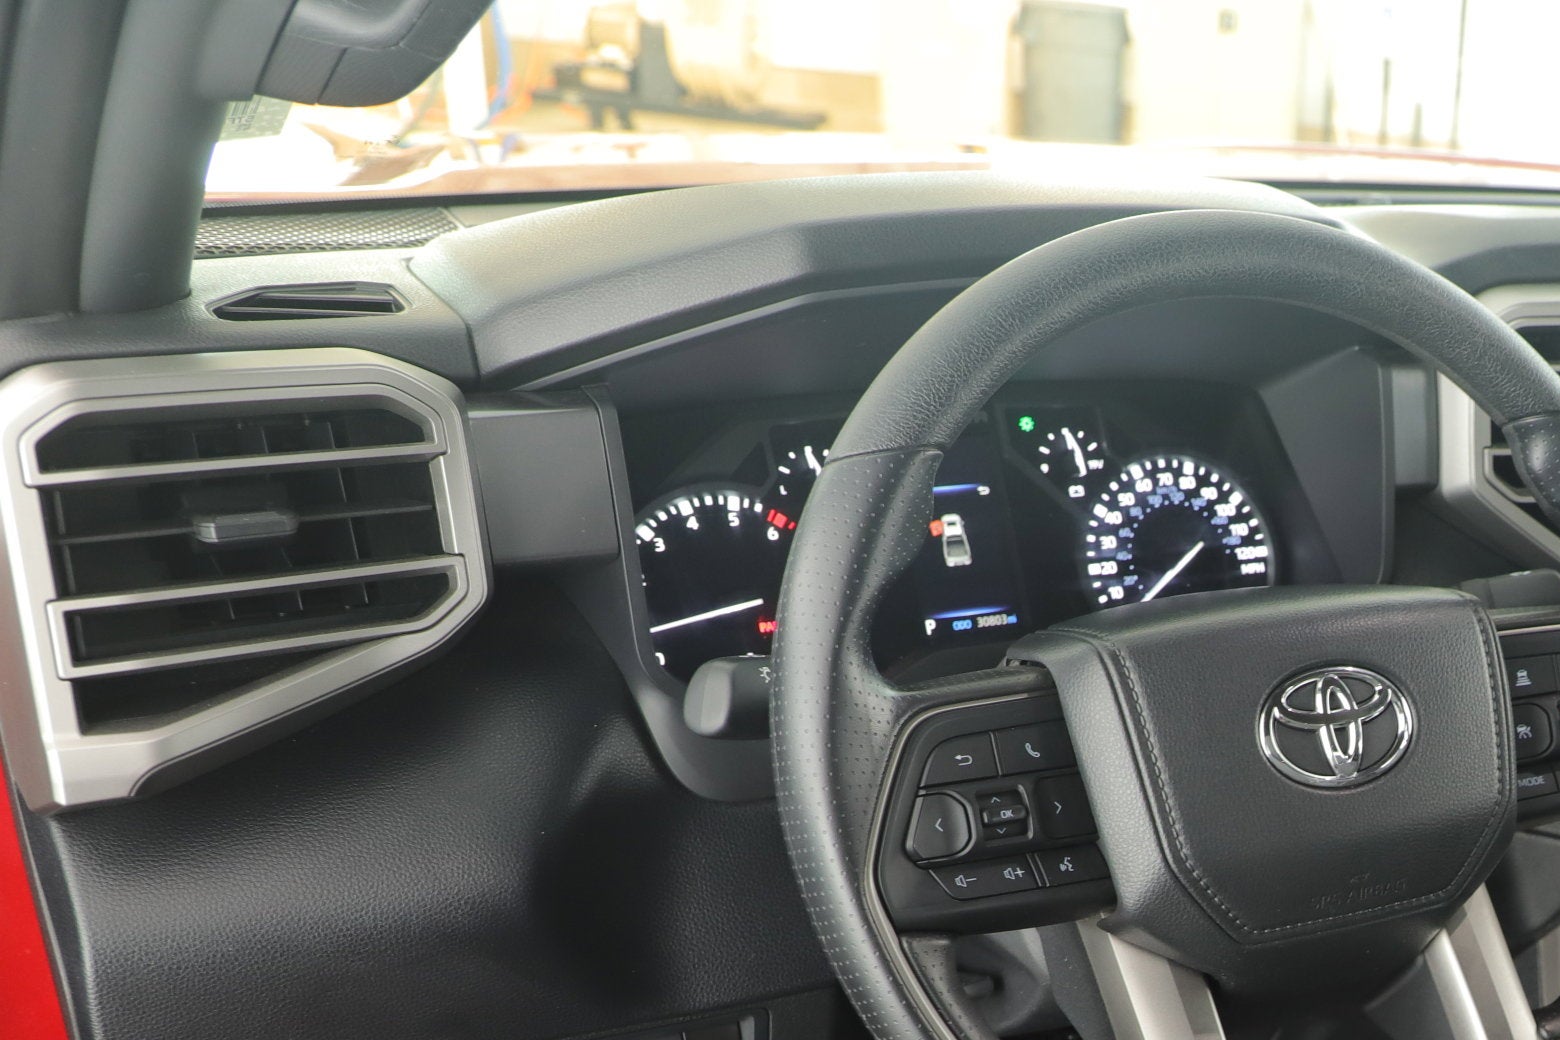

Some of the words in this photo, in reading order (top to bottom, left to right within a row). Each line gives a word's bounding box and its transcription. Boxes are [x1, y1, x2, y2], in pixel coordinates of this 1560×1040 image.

[1135, 478, 1153, 493] 60
[1155, 471, 1174, 486] 70
[1178, 475, 1197, 490] 80
[1116, 492, 1135, 507] 50
[1199, 486, 1218, 501] 90
[1104, 510, 1122, 525] 40
[1213, 503, 1237, 517] 100
[686, 515, 700, 531] 4
[728, 512, 740, 527] 5
[766, 526, 780, 541] 6
[1228, 522, 1250, 537] 110
[654, 537, 666, 553] 3
[1098, 534, 1117, 549] 30
[1101, 560, 1118, 575] 20
[1107, 585, 1125, 600] 10
[924, 618, 937, 636] P
[1518, 775, 1546, 788] MODE
[1000, 808, 1016, 819] OK
